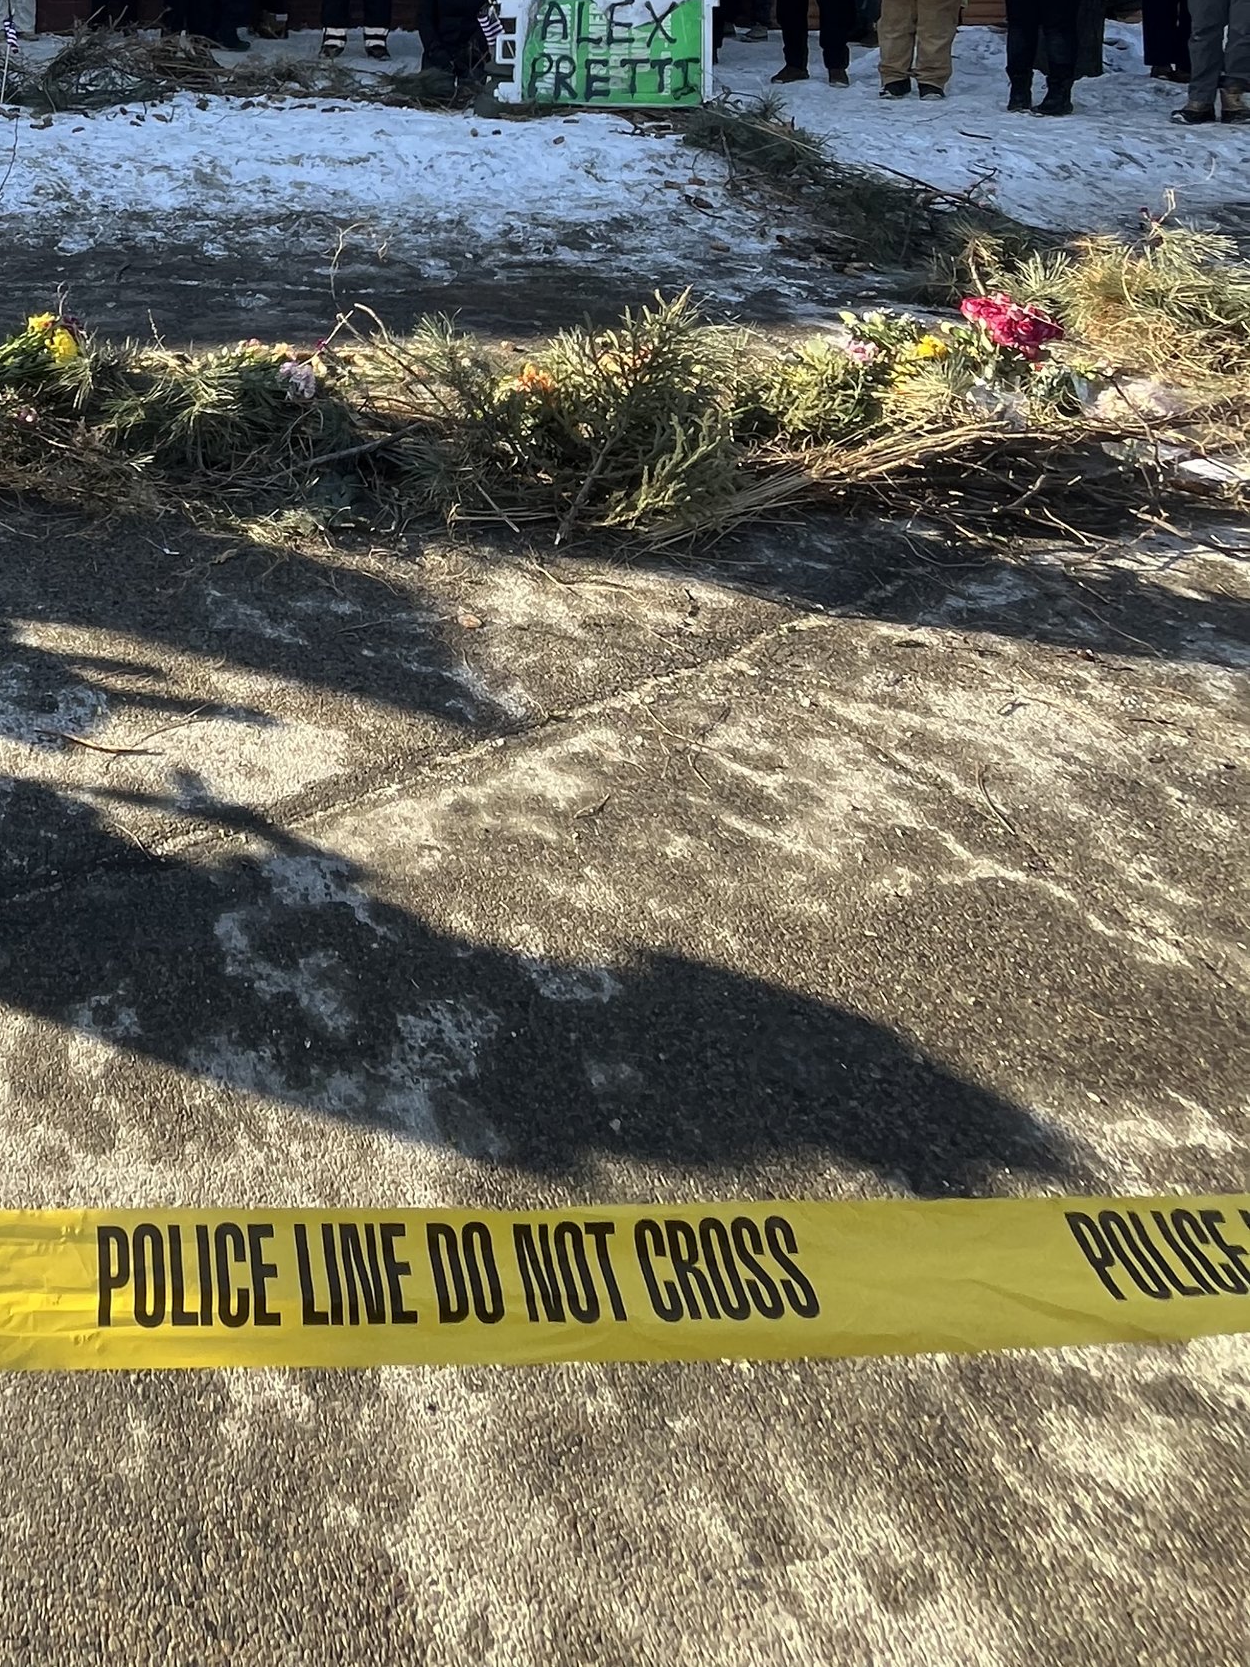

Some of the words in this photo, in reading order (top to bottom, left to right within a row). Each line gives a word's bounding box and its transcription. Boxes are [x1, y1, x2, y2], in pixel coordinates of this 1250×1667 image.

[527, 52, 700, 101] PRETTI
[97, 1222, 281, 1328] POLICE
[294, 1223, 418, 1326] LINE
[426, 1221, 505, 1324] DO
[512, 1220, 628, 1324] NOT
[634, 1215, 820, 1322] CROSS
[1064, 1208, 1250, 1301] POLICE
